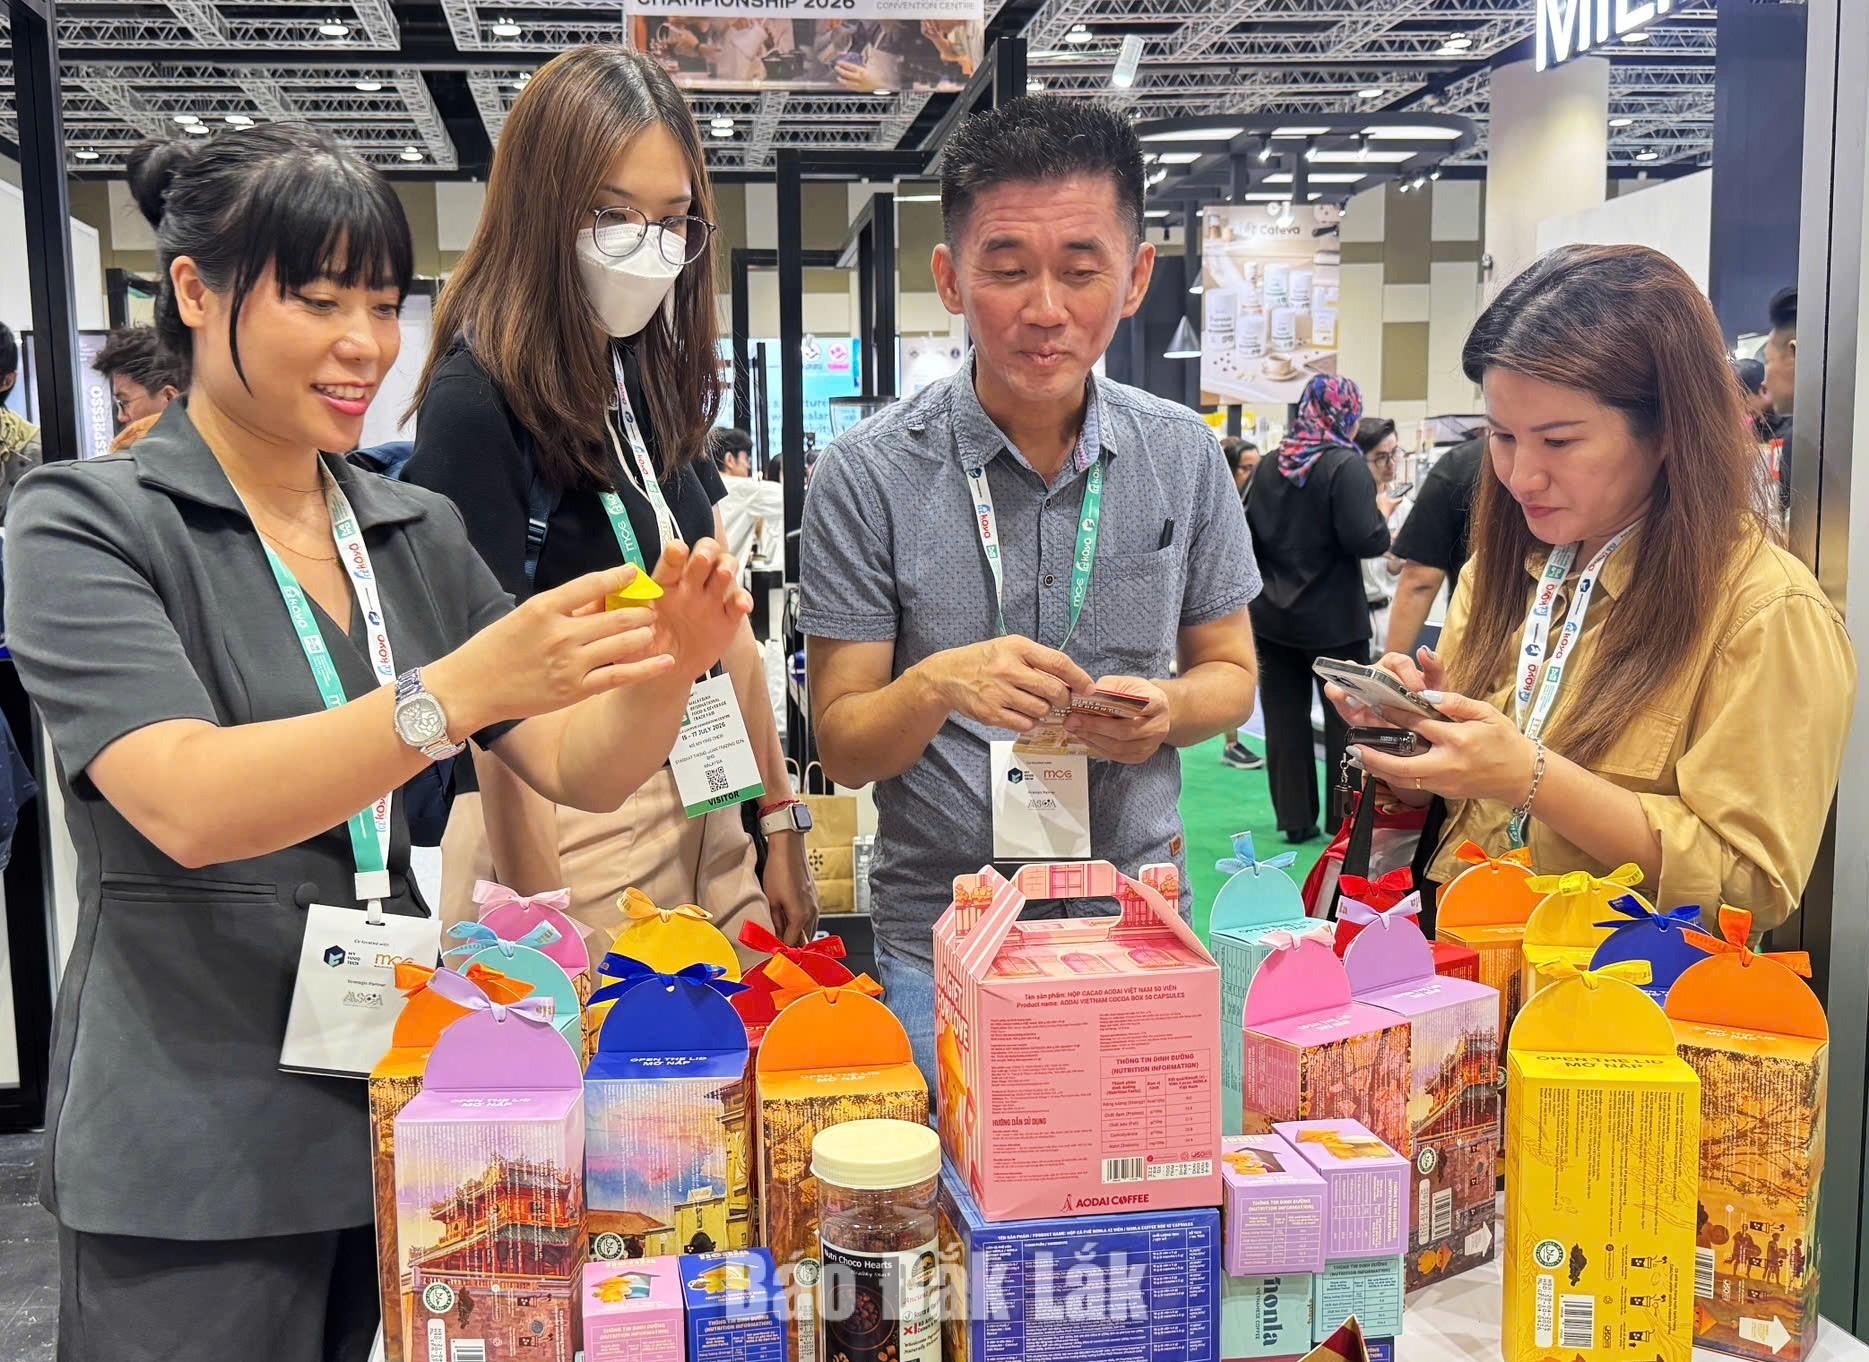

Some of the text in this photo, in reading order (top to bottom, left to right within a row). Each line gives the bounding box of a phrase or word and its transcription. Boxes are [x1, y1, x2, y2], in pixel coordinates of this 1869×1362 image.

[708, 790, 740, 805] VISITOR
[1016, 1001, 1040, 1009] Product
[1080, 997, 1108, 1005] VIETNAM
[1153, 992, 1185, 1000] CAPSULES
[1536, 1055, 1588, 1063] OPEN
[1592, 1056, 1630, 1064] THE
[1076, 1193, 1150, 1208] AODAI COFFEE
[838, 1253, 862, 1268] Choco
[864, 1260, 893, 1269] Hearts
